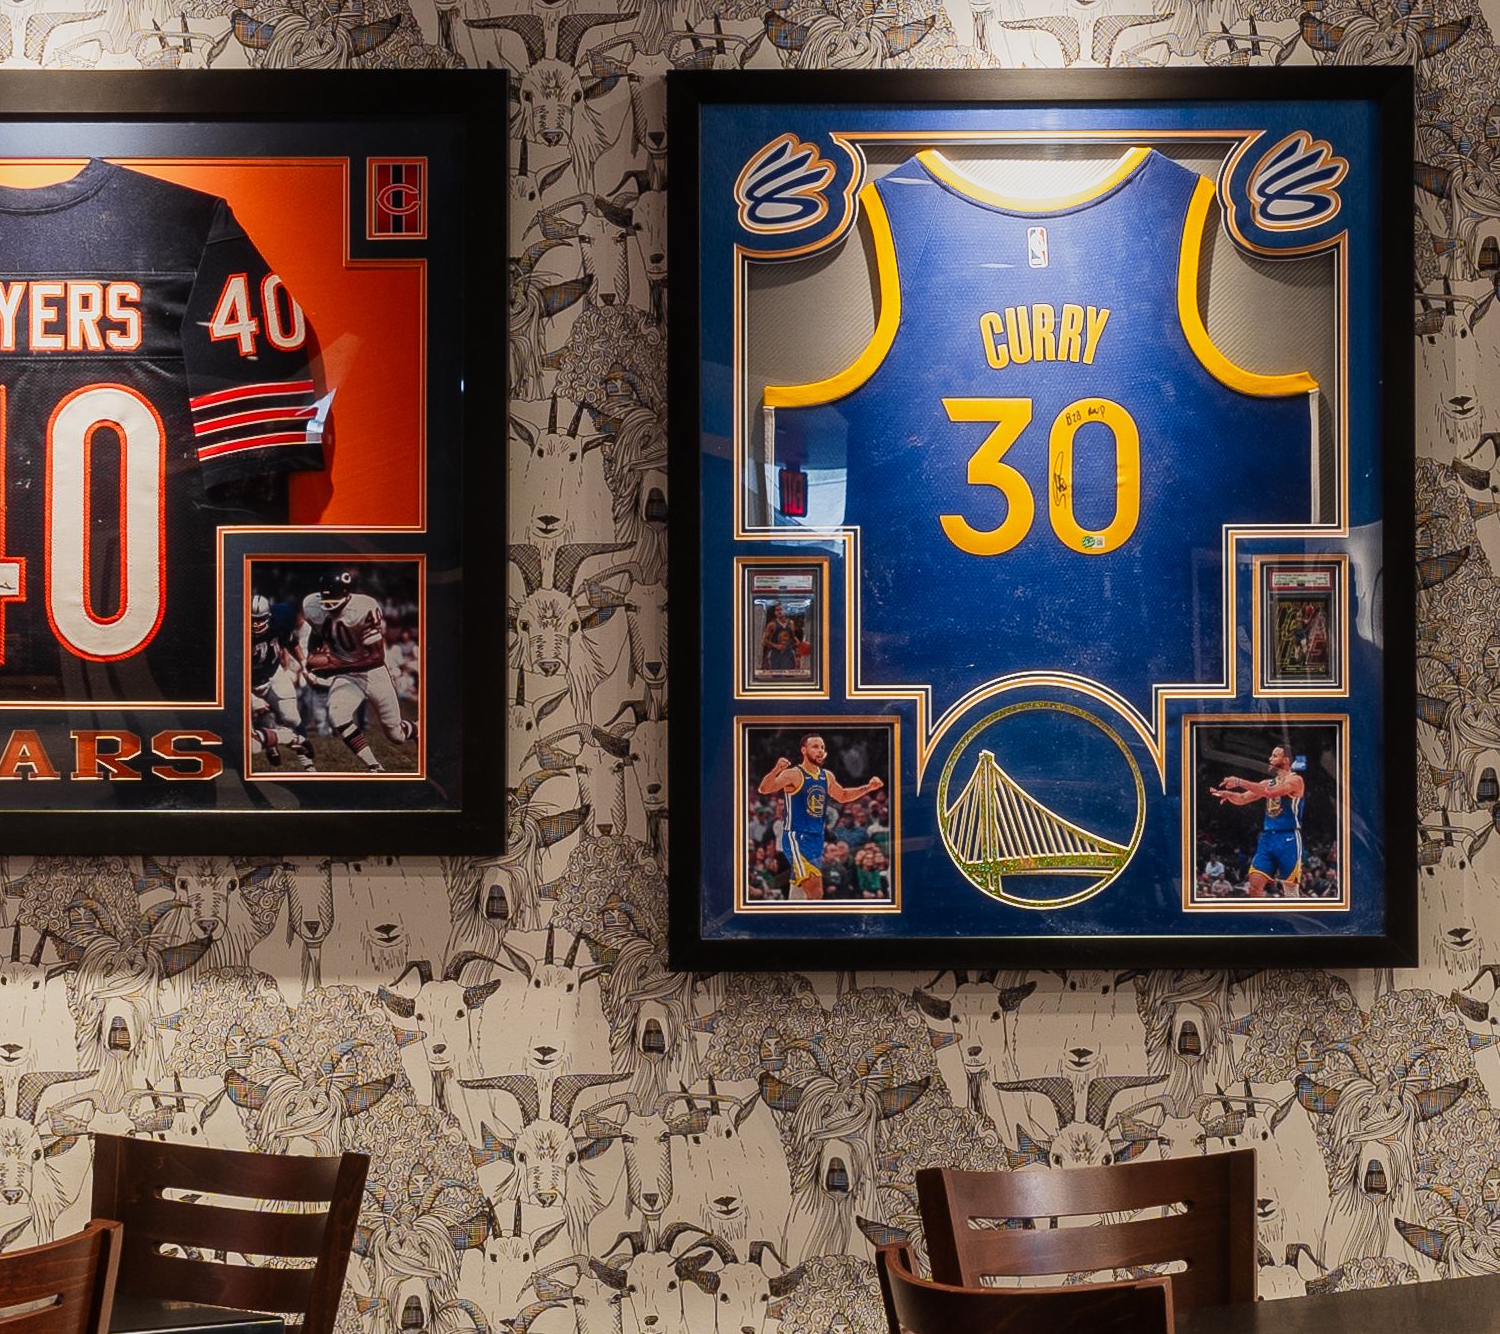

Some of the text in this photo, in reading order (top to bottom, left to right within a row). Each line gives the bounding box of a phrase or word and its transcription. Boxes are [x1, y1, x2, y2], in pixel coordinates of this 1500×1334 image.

[209, 271, 306, 356] 40
[979, 303, 1111, 370] CURRY
[939, 396, 1140, 557] 30
